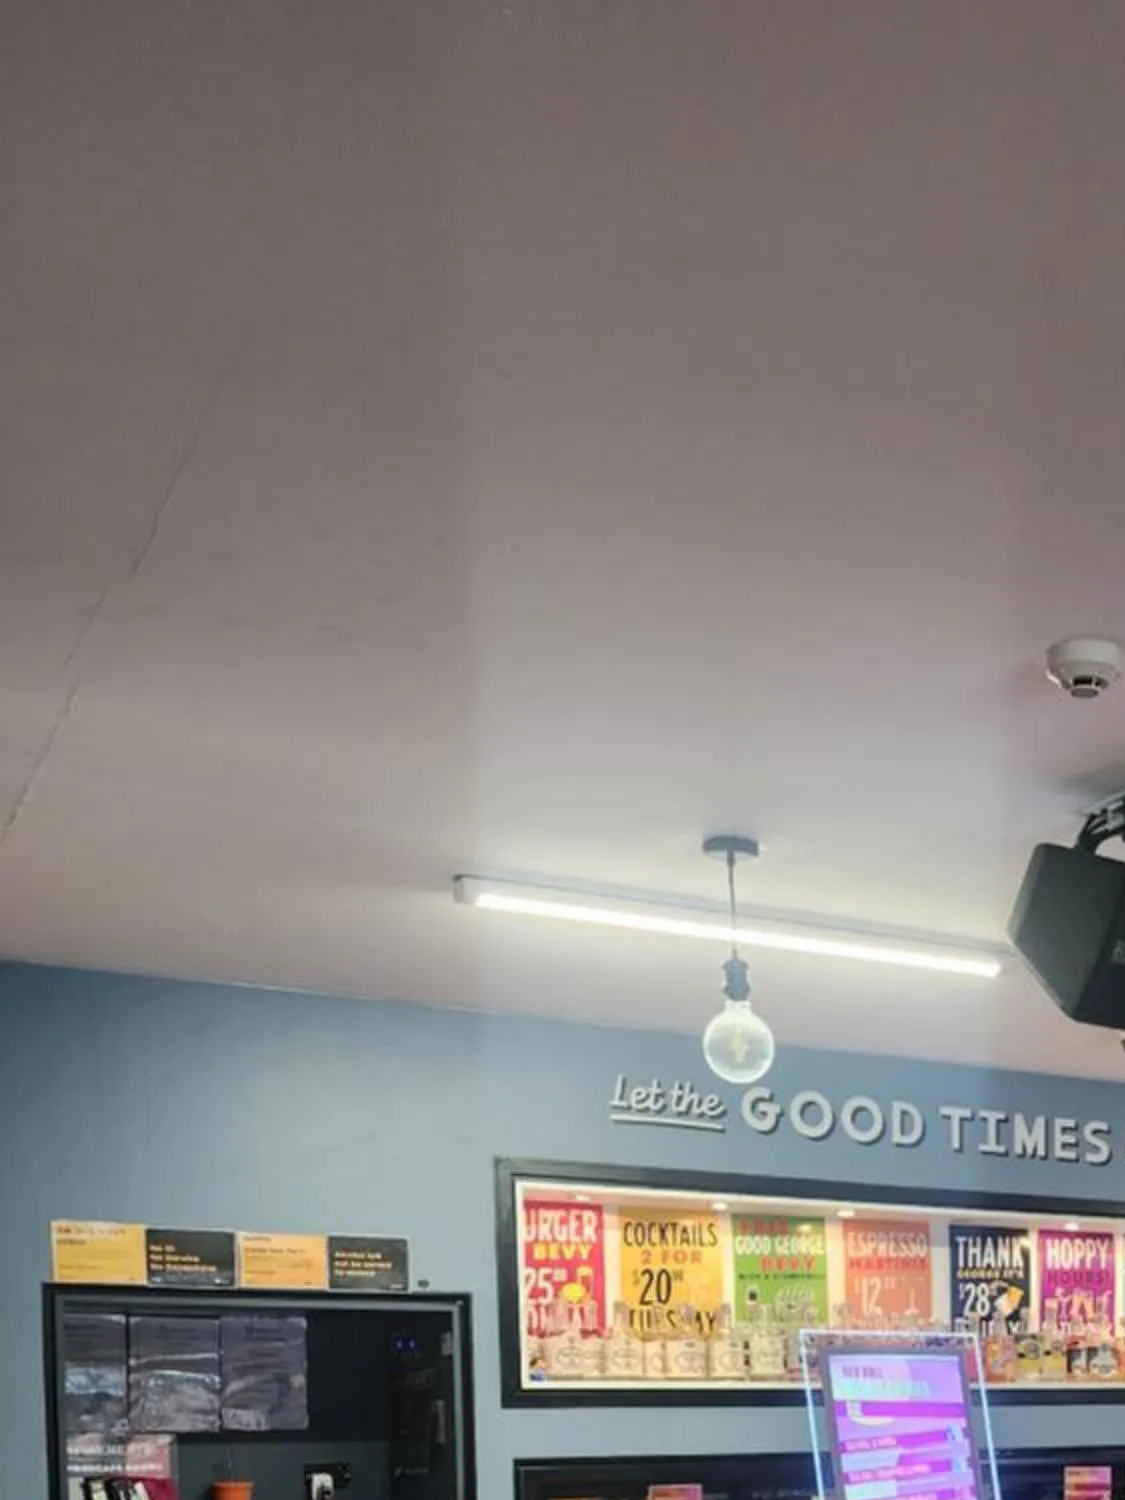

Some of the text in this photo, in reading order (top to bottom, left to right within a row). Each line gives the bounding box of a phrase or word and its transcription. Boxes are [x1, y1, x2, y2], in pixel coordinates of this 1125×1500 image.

[611, 1074, 663, 1112] Let
[668, 1080, 728, 1116] the
[740, 1086, 925, 1147] GOOD
[938, 1105, 1113, 1165] TIMES
[523, 1210, 597, 1243] URGER
[623, 1221, 719, 1248] COCKTAILS
[534, 1243, 593, 1260] BEVY
[661, 1249, 702, 1265] FOR
[847, 1231, 927, 1258] ESPRESSO
[955, 1235, 1024, 1269] THANK
[1046, 1238, 1109, 1270] HOPPY
